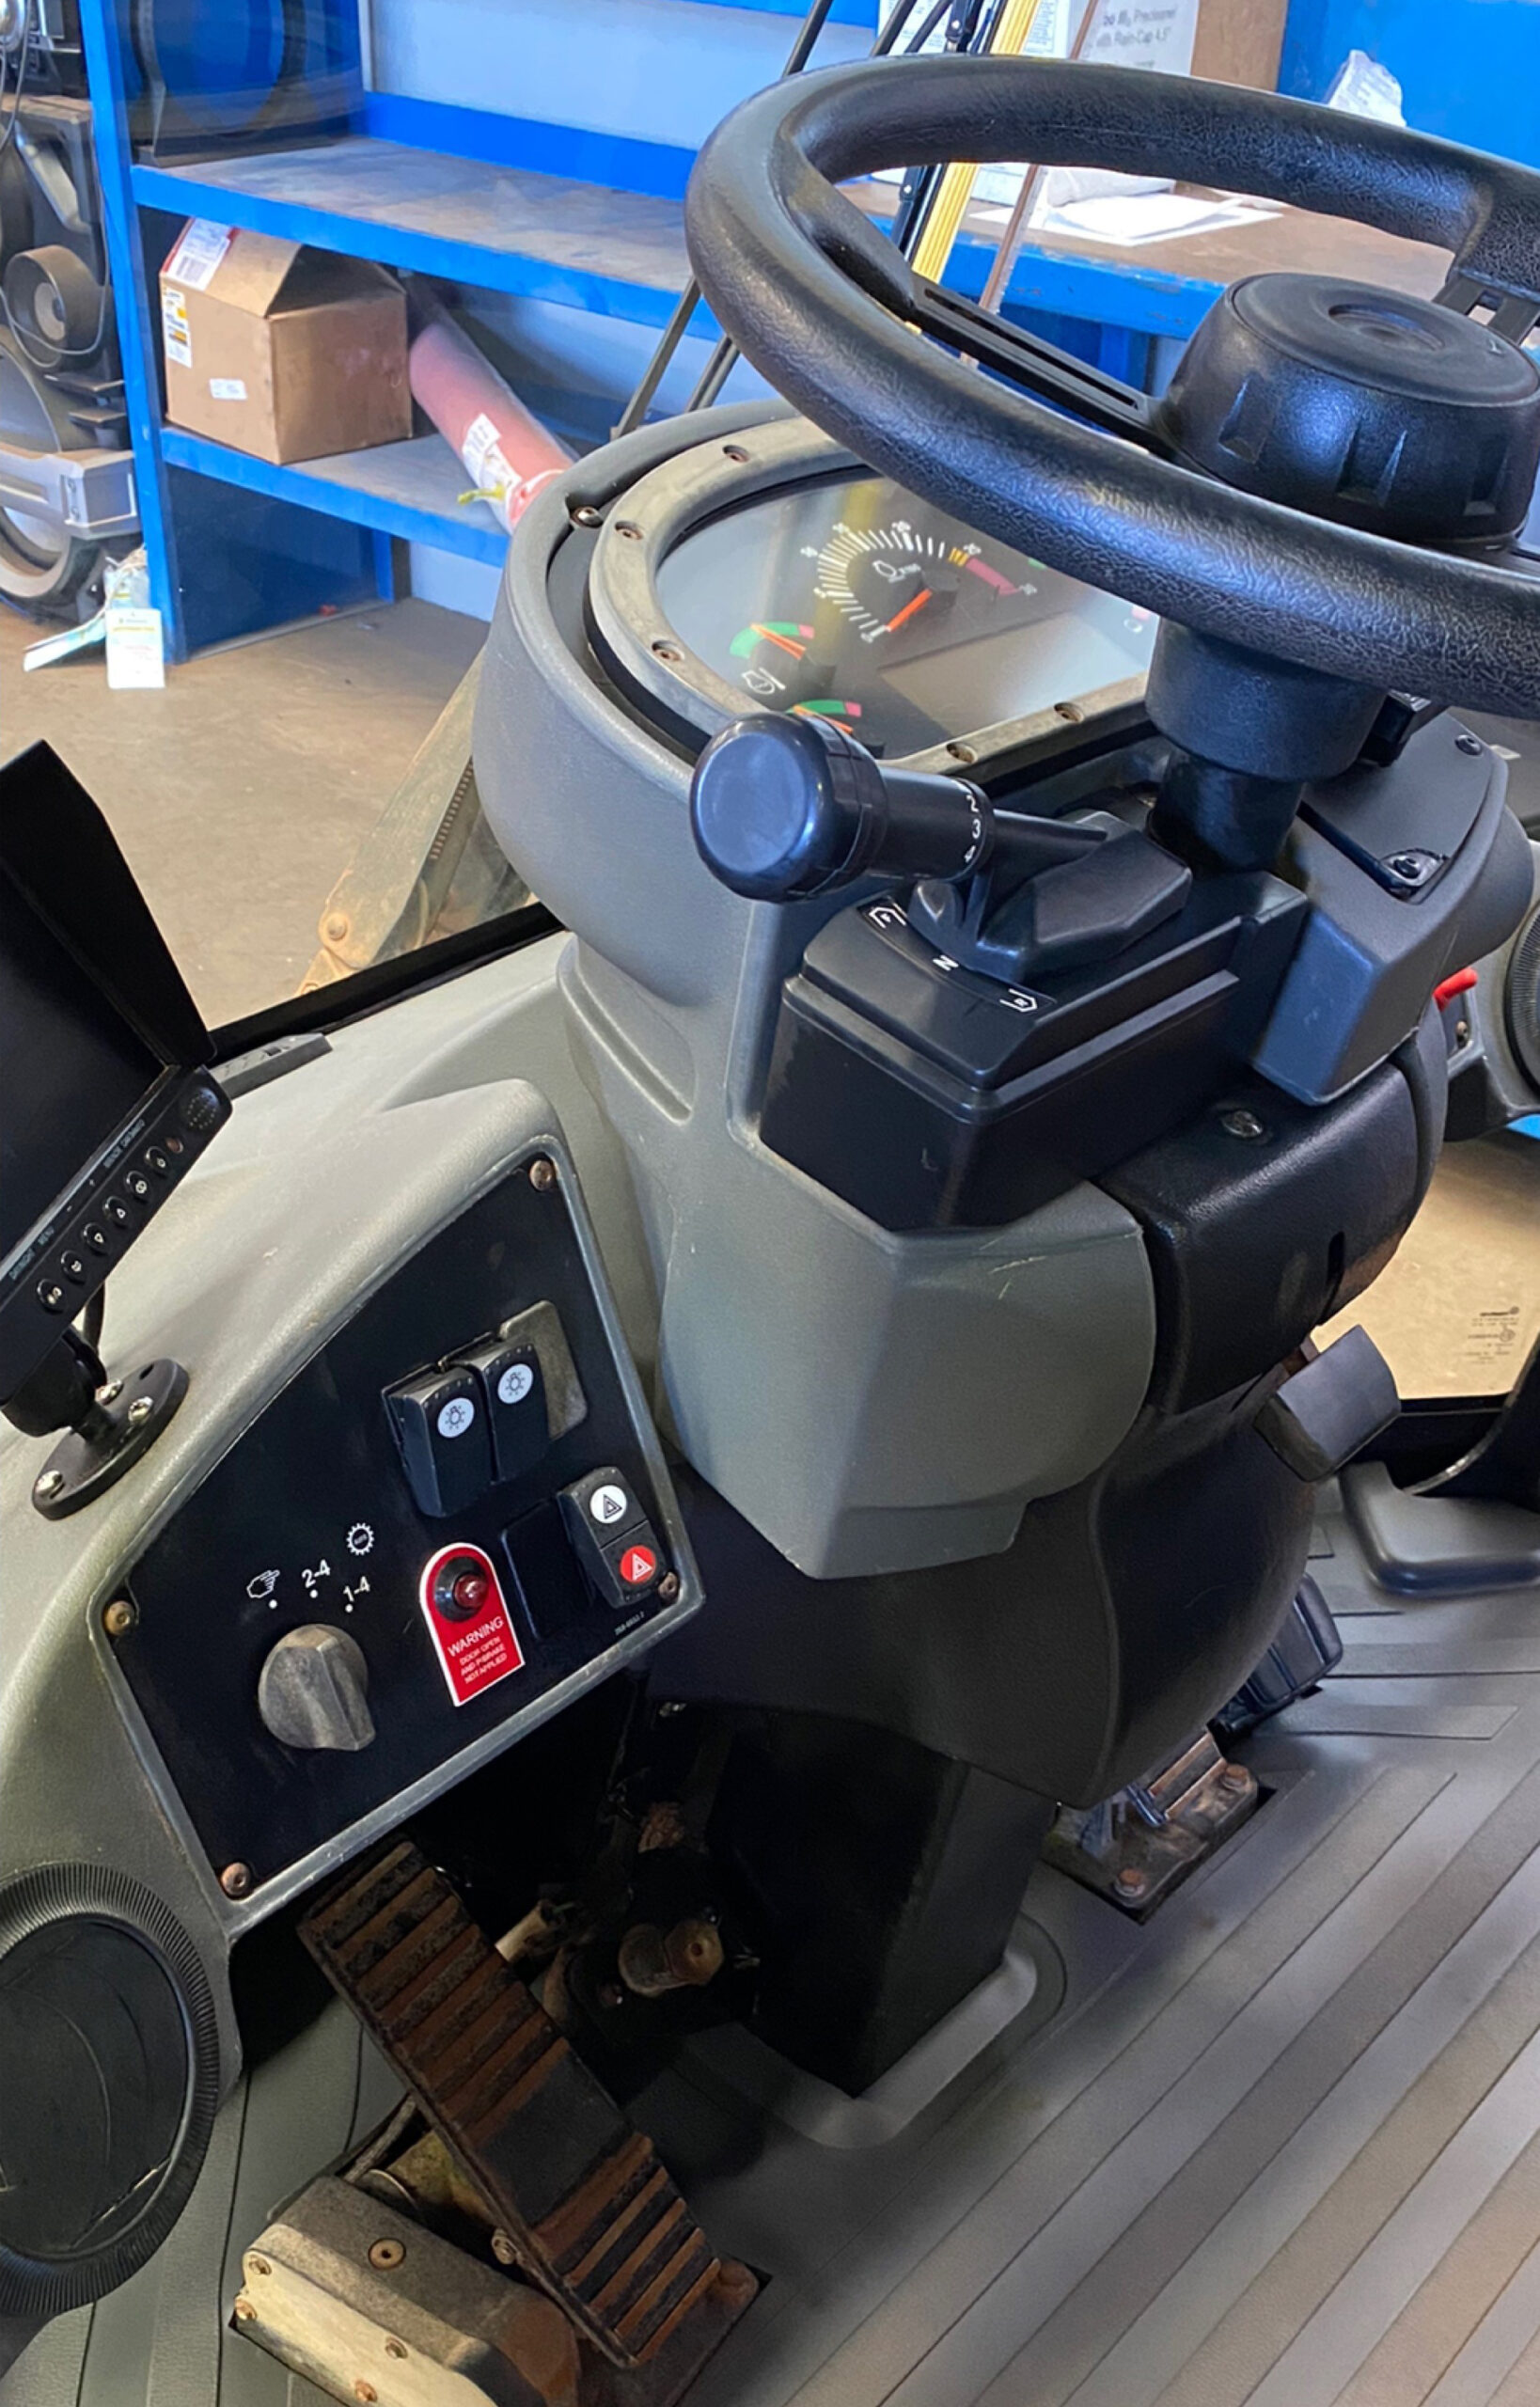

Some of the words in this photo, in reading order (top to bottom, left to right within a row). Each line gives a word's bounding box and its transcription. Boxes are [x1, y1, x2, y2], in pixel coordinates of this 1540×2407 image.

[966, 794, 980, 813] 2
[971, 817, 982, 840] 3
[933, 954, 959, 971] N
[301, 1558, 332, 1589] 2-4
[342, 1575, 371, 1603] 1-4
[447, 1615, 505, 1658] WARNING
[459, 1647, 481, 1667] DOOR
[480, 1635, 502, 1653] OPEN
[461, 1660, 477, 1677] AND
[464, 1669, 479, 1684] NOT
